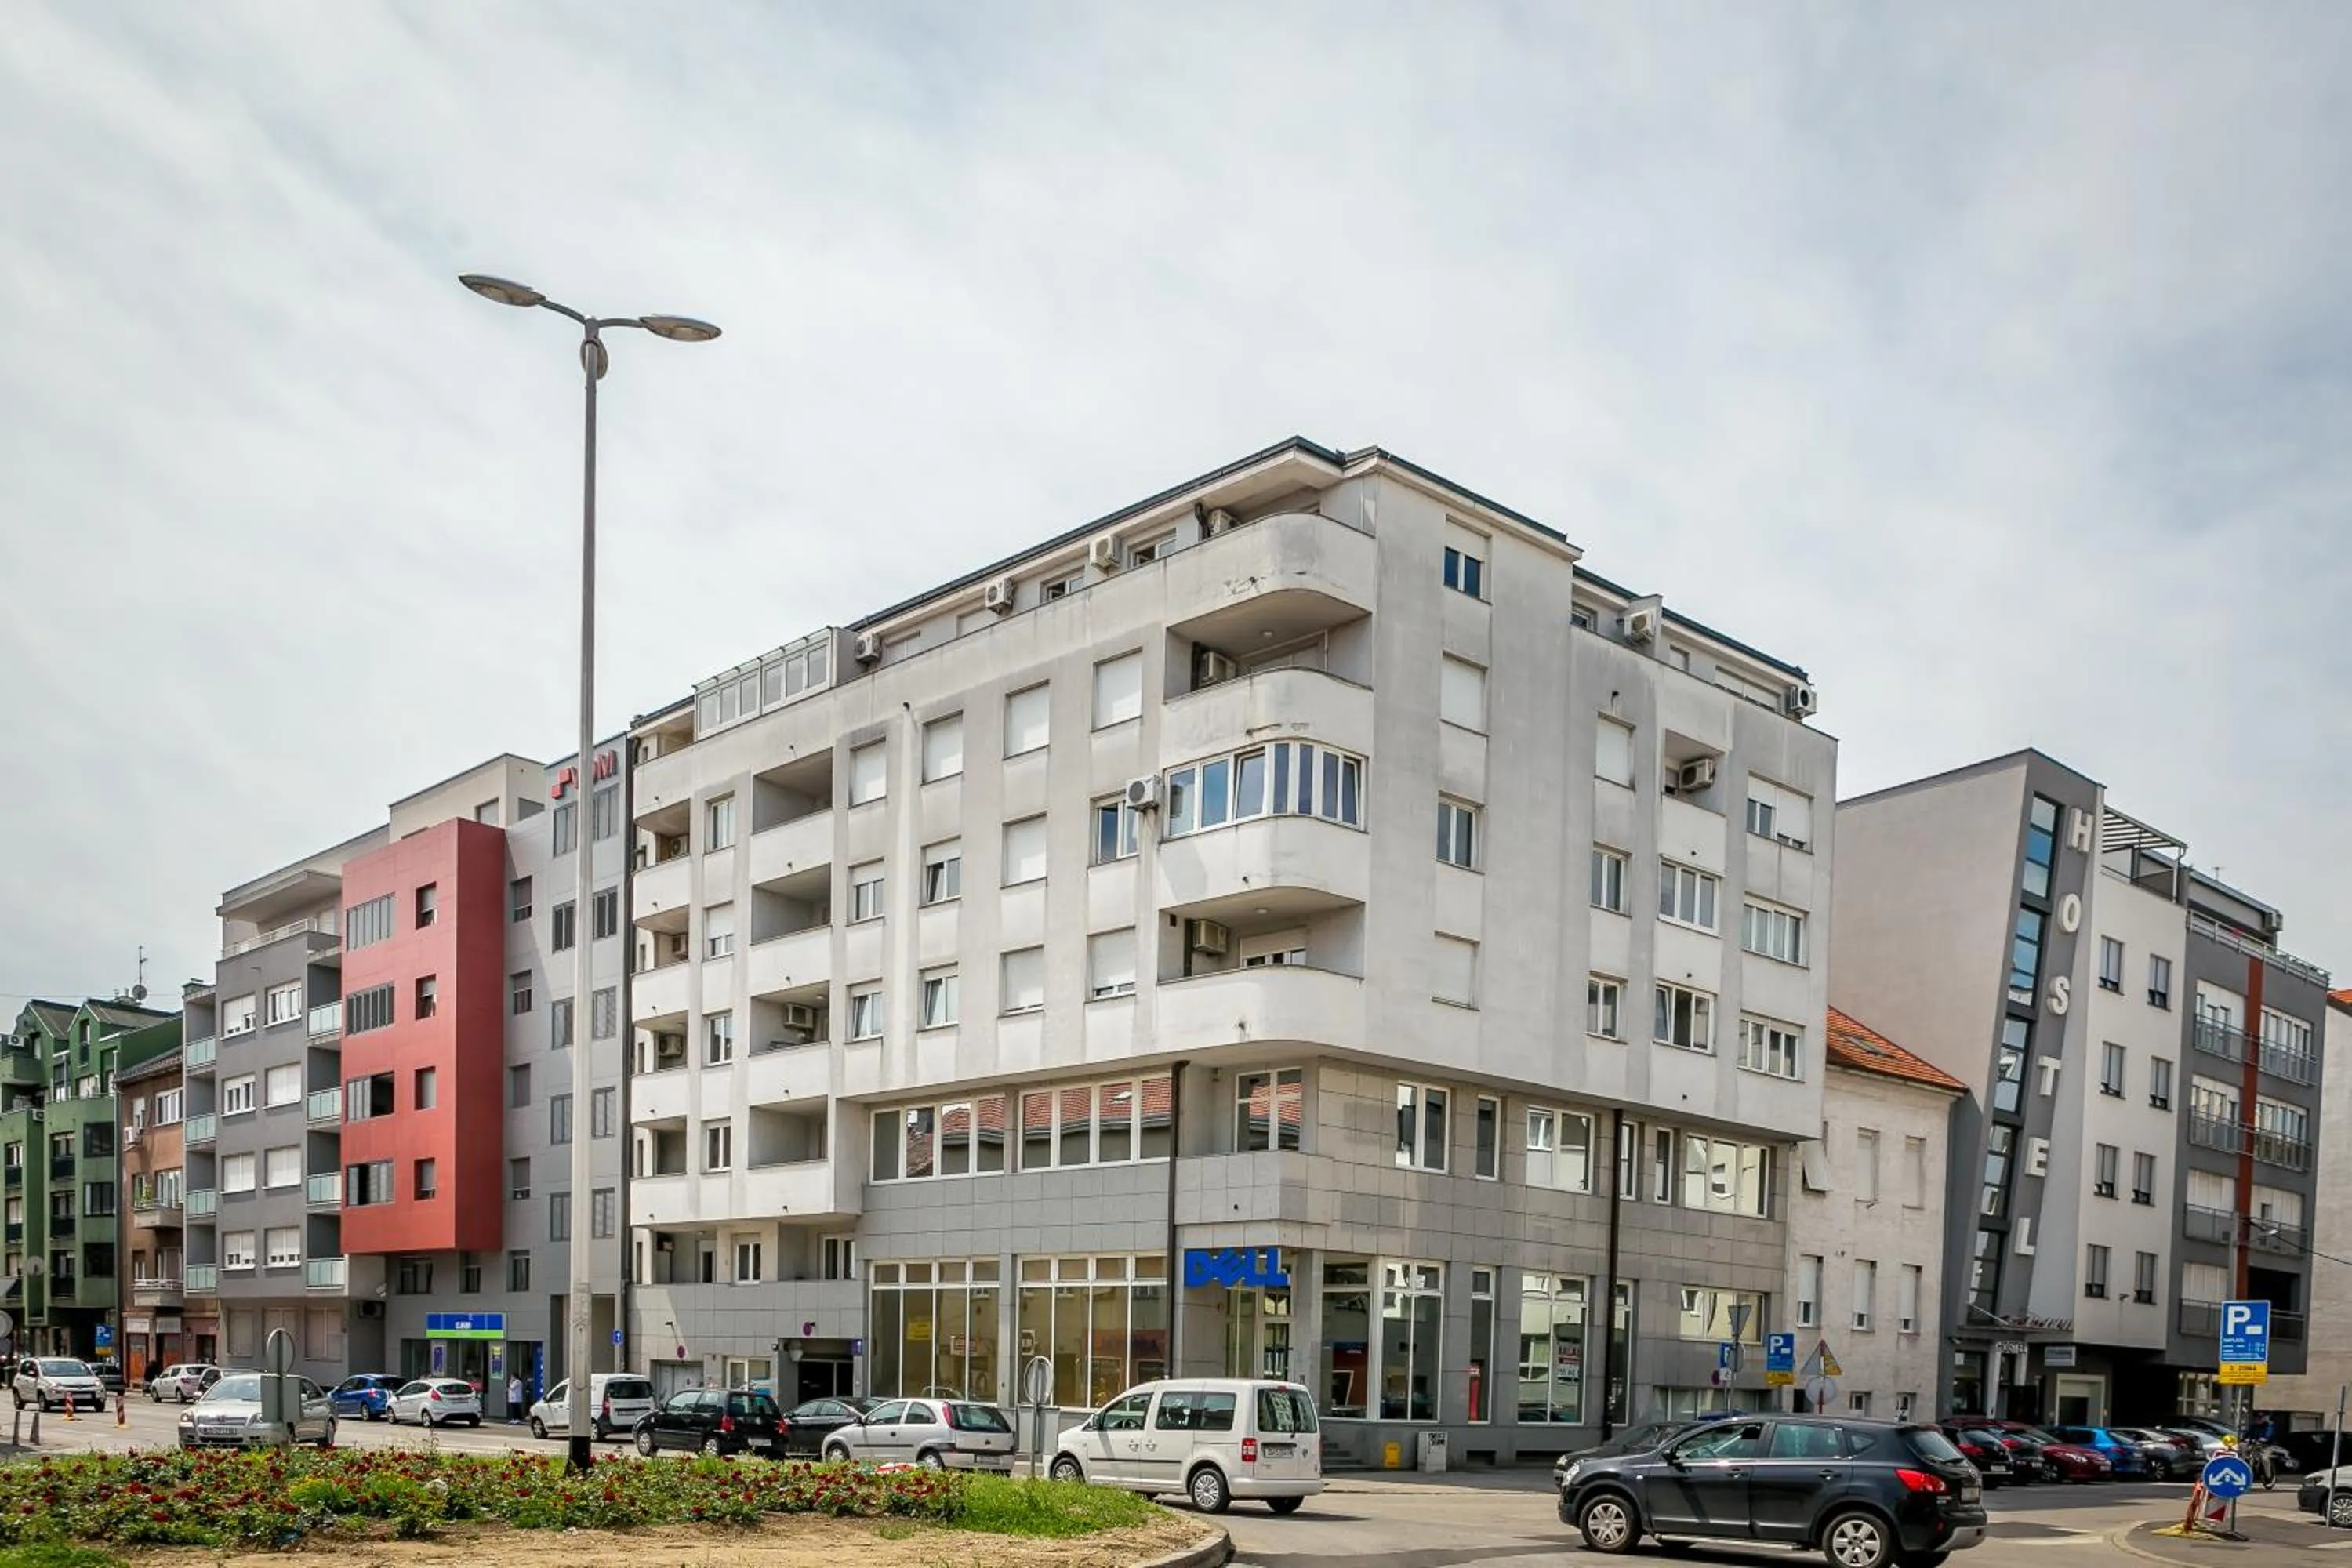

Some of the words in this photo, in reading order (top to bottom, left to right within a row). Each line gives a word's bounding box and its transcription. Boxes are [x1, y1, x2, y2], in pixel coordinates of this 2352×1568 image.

[2013, 806, 2095, 1257] HOSTEL
[1184, 1246, 1289, 1288] DELL
[96, 1326, 106, 1338] P
[2227, 1305, 2251, 1335] P
[1769, 1335, 1784, 1355] P
